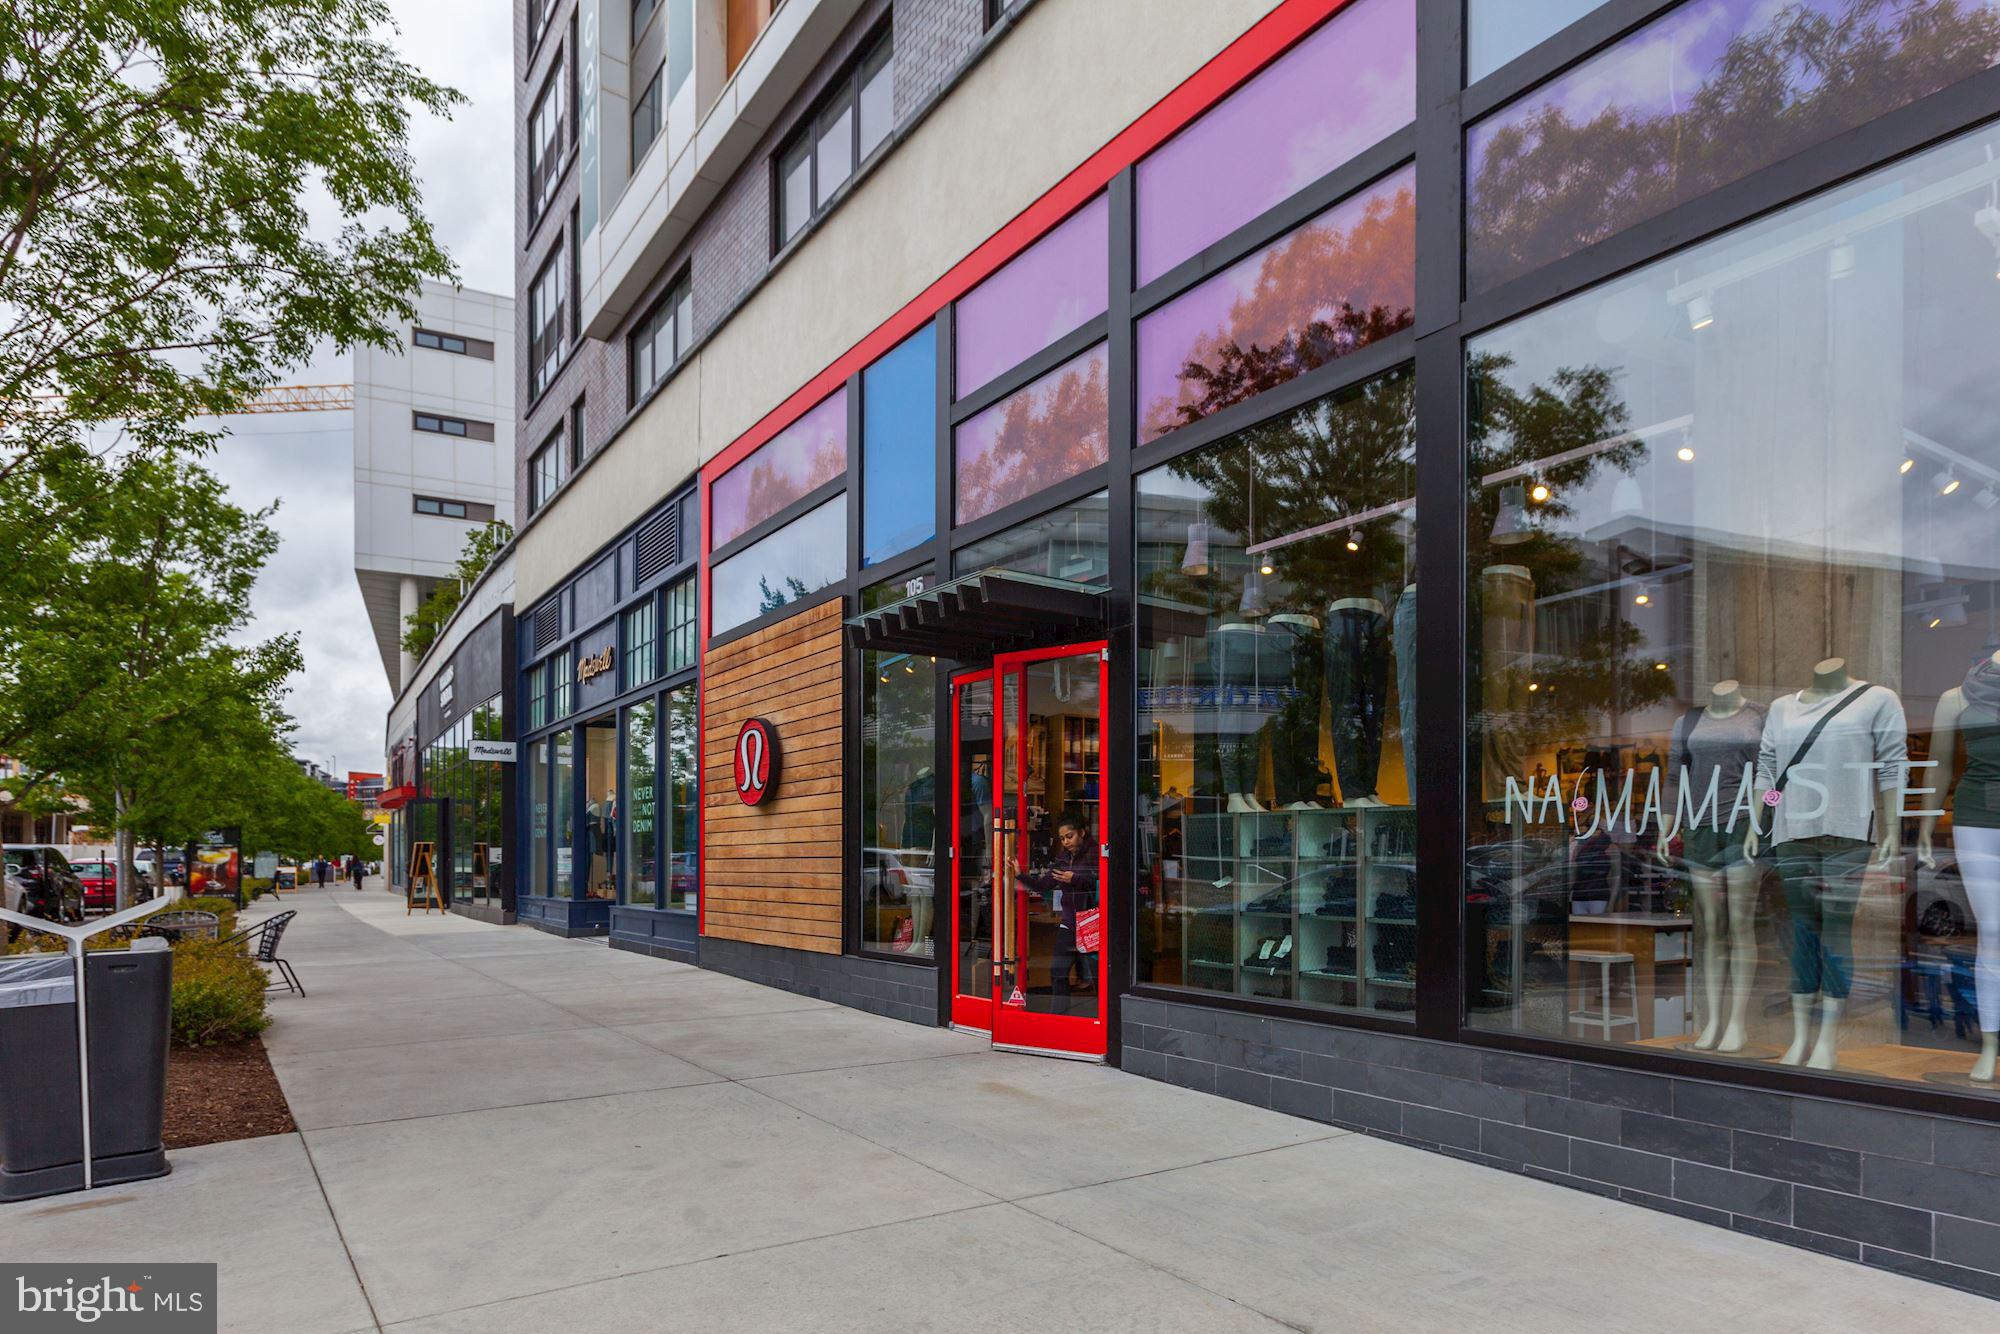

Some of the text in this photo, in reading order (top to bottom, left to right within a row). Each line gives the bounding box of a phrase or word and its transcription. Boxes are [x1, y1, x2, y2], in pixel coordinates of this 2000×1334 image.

[905, 576, 924, 598] 105
[633, 785, 654, 801] NEVER
[642, 802, 656, 816] NOT
[632, 819, 653, 833] DENIM
